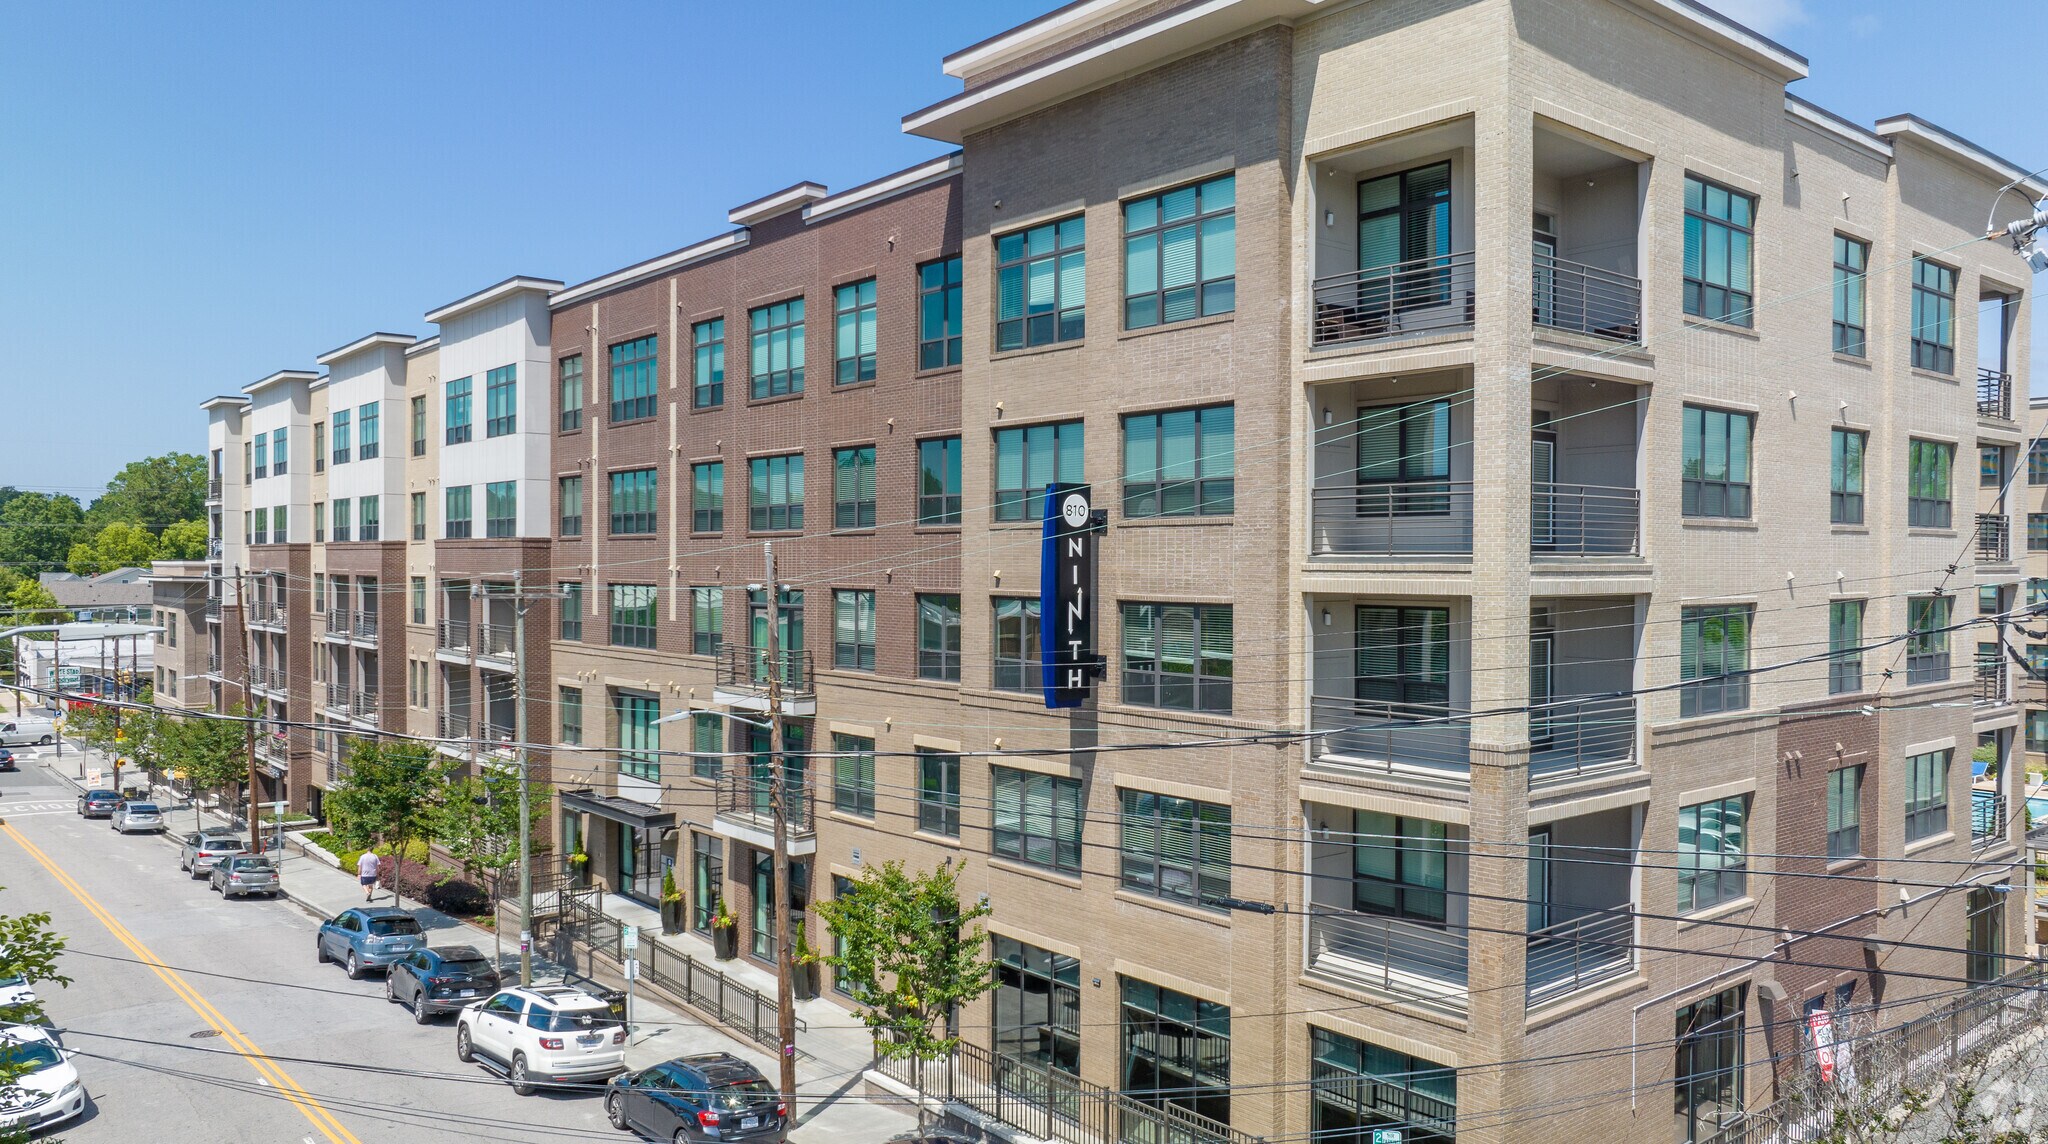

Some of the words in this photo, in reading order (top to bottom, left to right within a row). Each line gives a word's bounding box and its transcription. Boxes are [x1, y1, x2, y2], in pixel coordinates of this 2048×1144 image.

[1065, 504, 1086, 517] 810
[1067, 537, 1083, 690] NINTH
[0, 802, 78, 813] SCHOO
[1375, 1132, 1382, 1143] 2
